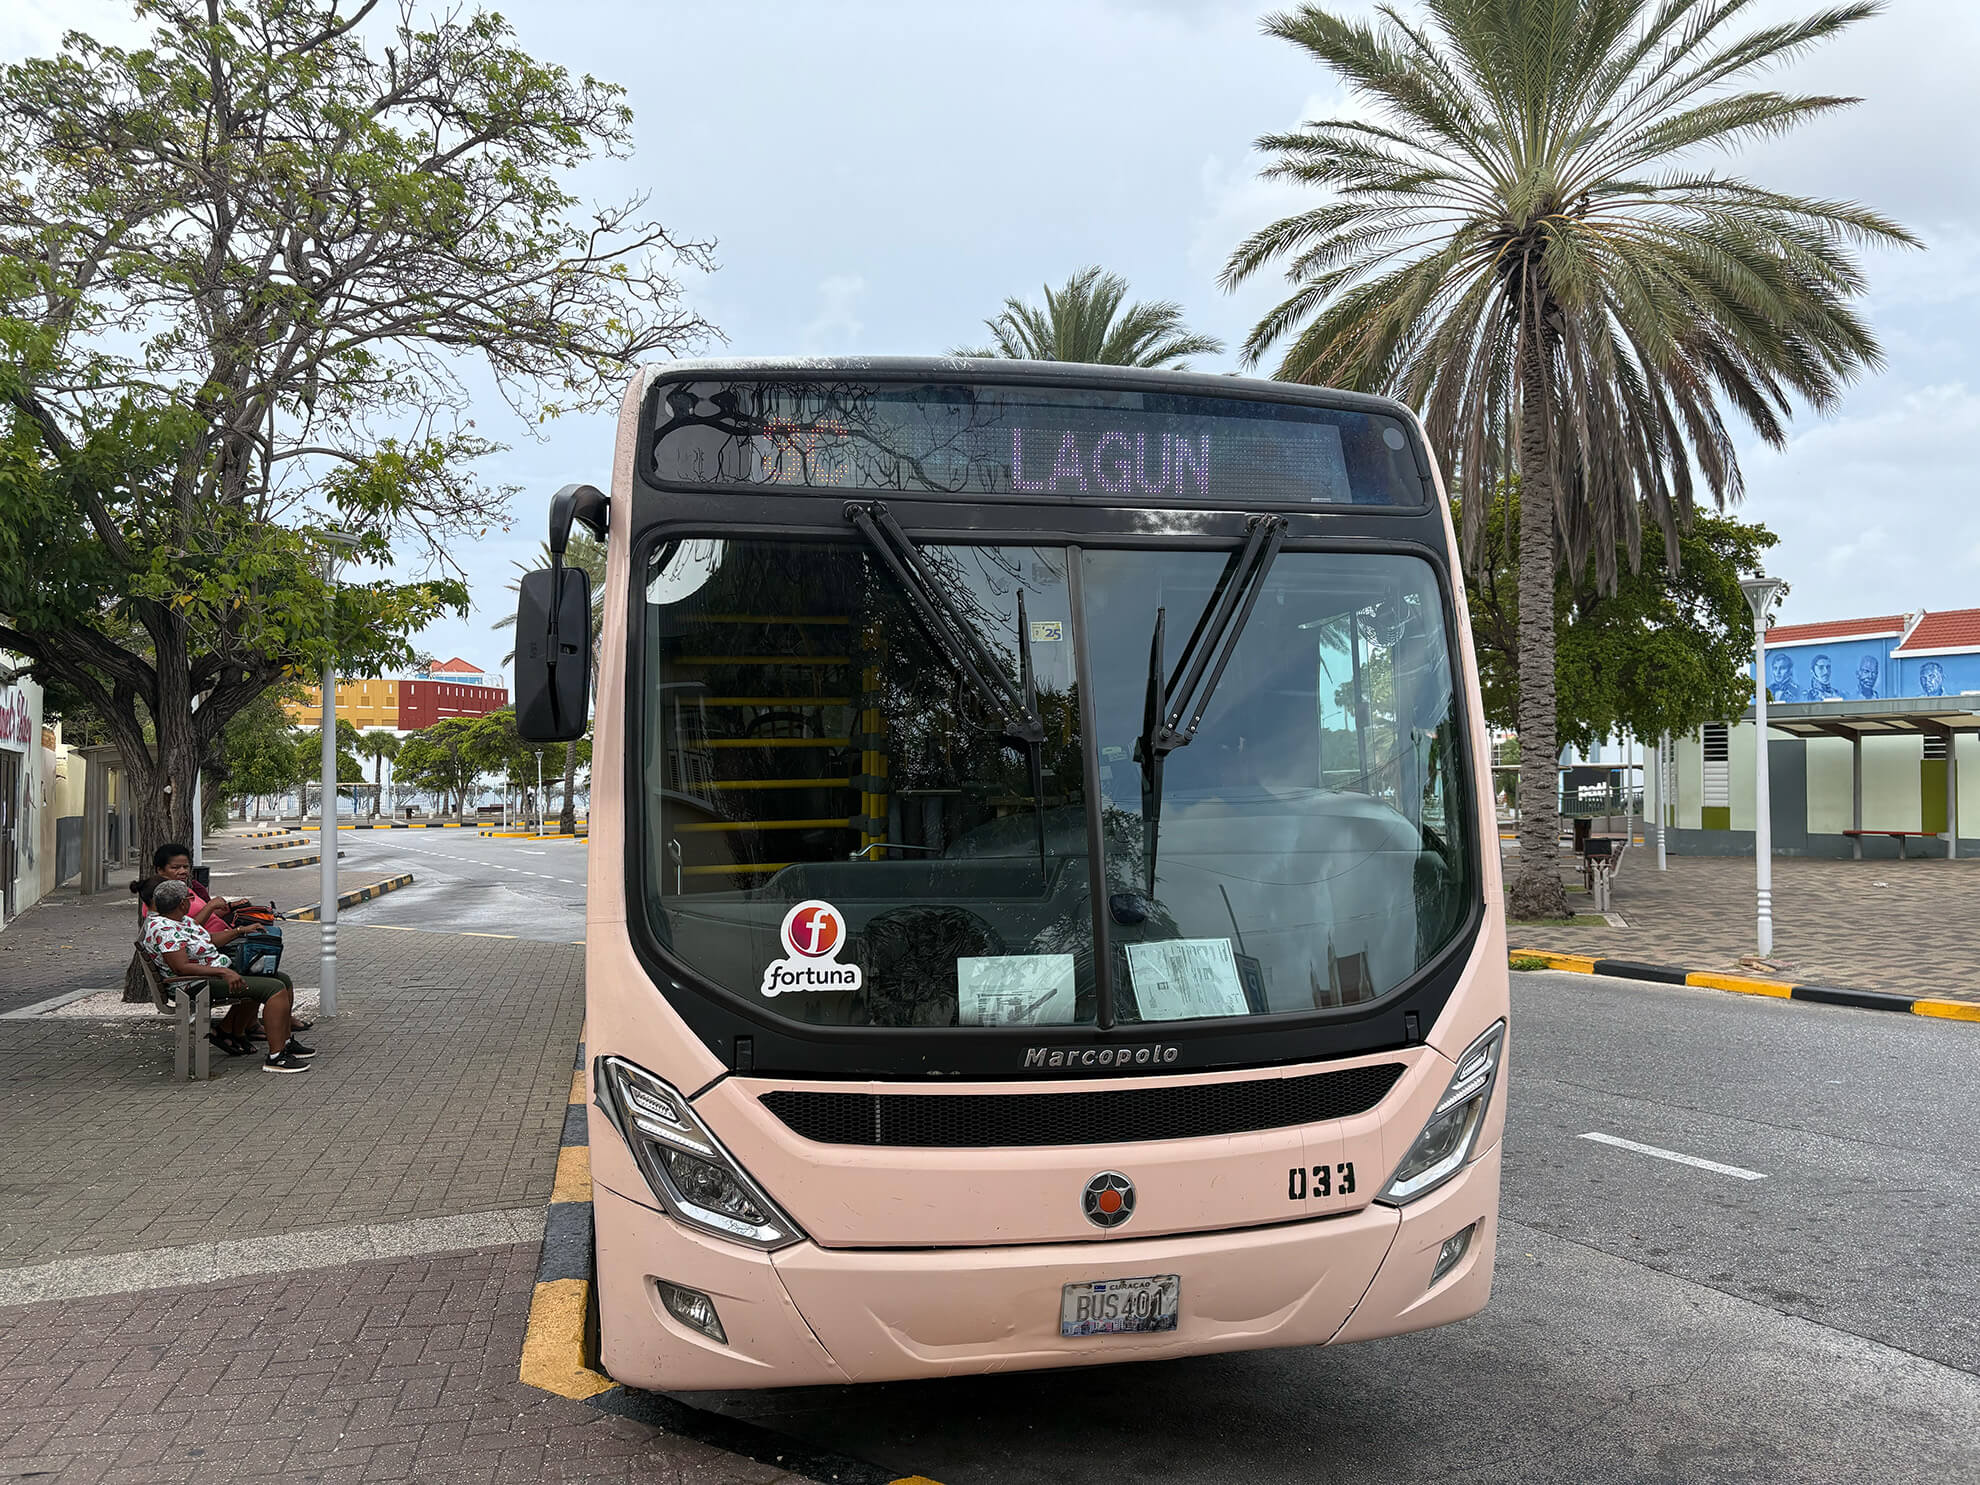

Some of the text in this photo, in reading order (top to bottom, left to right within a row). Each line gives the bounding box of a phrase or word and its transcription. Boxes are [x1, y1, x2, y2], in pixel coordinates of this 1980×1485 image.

[1012, 428, 1210, 495] LAGUN
[1045, 628, 1062, 641] 25
[768, 965, 856, 991] fortuna
[1023, 1044, 1179, 1068] Marcopolo
[1288, 1162, 1356, 1200] 033
